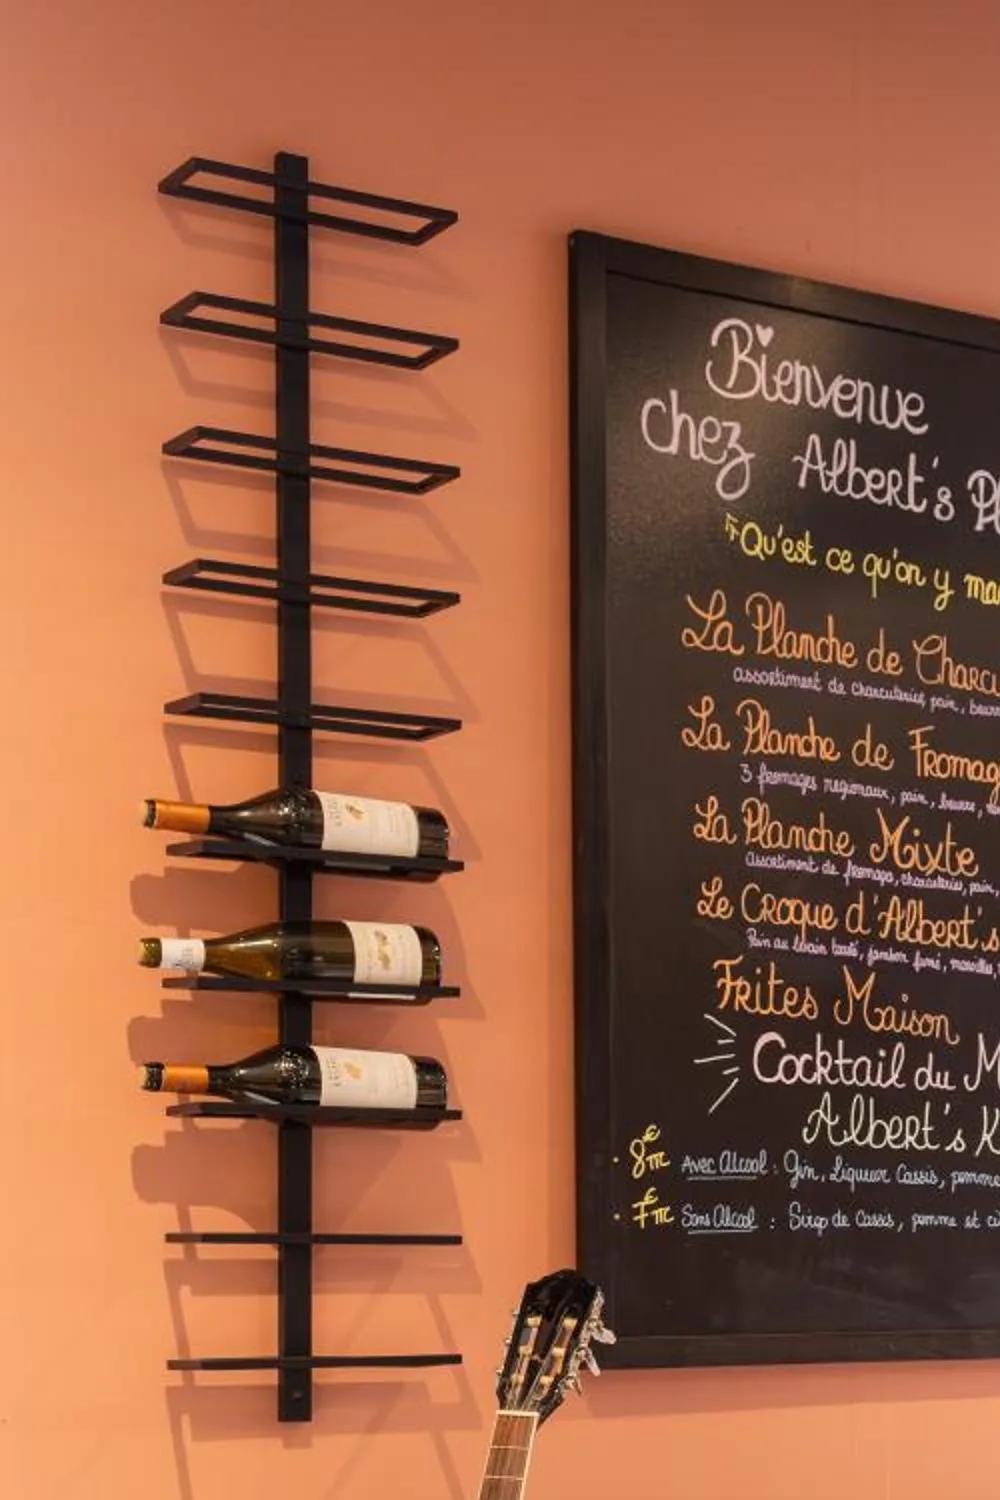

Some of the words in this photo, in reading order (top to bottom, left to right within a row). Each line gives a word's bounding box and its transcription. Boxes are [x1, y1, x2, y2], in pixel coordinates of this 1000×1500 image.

[707, 318, 928, 434] Bienvenue
[793, 435, 954, 522] Albert's
[826, 547, 855, 574] ce
[862, 547, 927, 599] qu'on
[933, 567, 956, 611] y
[682, 589, 745, 655] La
[746, 592, 859, 669] Planche
[866, 628, 904, 676] de
[828, 676, 847, 695] de
[681, 695, 731, 751] La
[736, 699, 841, 761] Planche
[852, 724, 895, 771] de
[739, 763, 753, 783] 3
[693, 796, 737, 845] La
[741, 797, 854, 858] Planche
[870, 808, 979, 877] Mixte
[822, 859, 840, 875] de
[697, 876, 735, 920] Le
[741, 883, 839, 944] Croque
[746, 927, 771, 948] Pain
[773, 937, 789, 950] au
[713, 955, 818, 1021] Frites
[834, 964, 960, 1045] Maison
[753, 1031, 906, 1088] Cocktail
[914, 1052, 957, 1091] du
[802, 1091, 967, 1153] Albert's
[645, 1151, 672, 1171] TTC
[651, 1205, 675, 1225] TTC
[681, 1203, 711, 1227] Sans
[789, 1201, 829, 1237] Sirop
[832, 1209, 850, 1227] de
[912, 1212, 957, 1232] pomme
[964, 1209, 981, 1229] et
